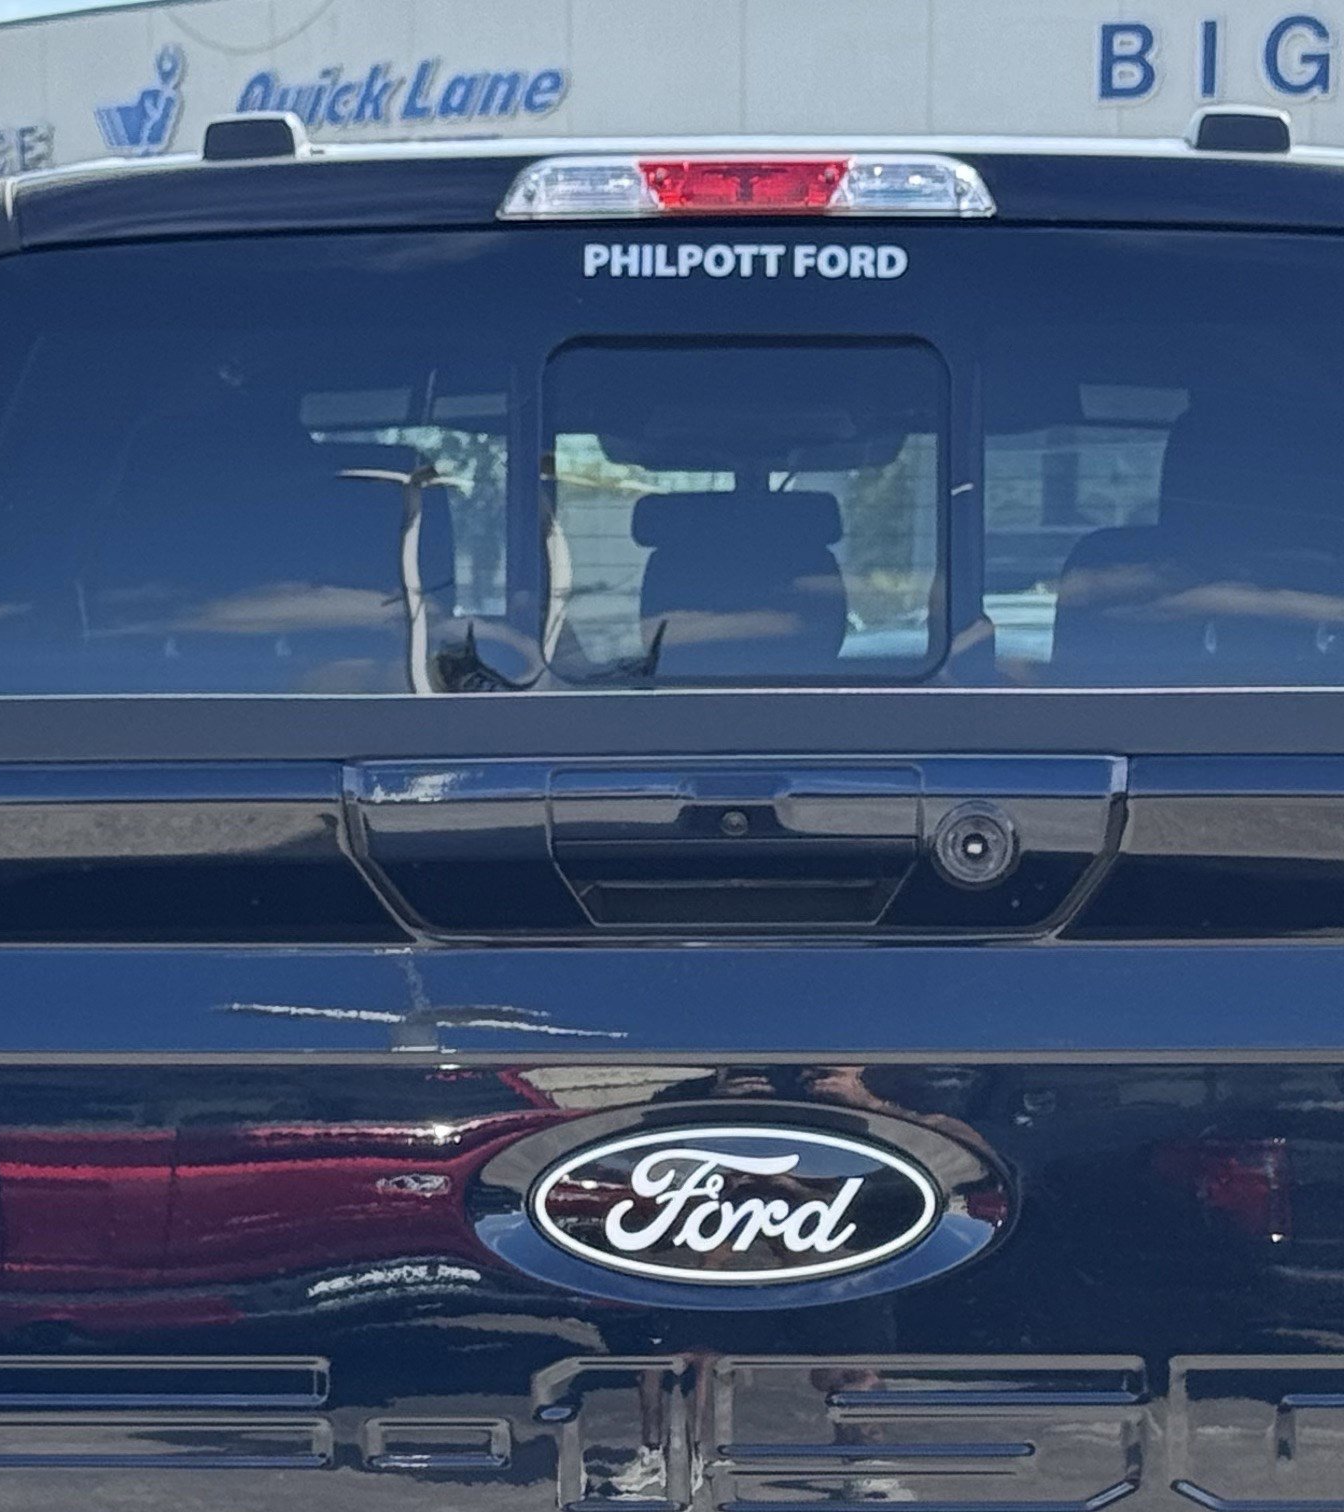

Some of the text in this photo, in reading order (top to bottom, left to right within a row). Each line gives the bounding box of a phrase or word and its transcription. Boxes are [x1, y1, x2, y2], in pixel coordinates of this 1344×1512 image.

[235, 57, 567, 126] Quick Lane
[1098, 13, 1332, 100] BIG
[583, 243, 909, 280] PHILPOTT FORD
[604, 1147, 865, 1253] Ford
